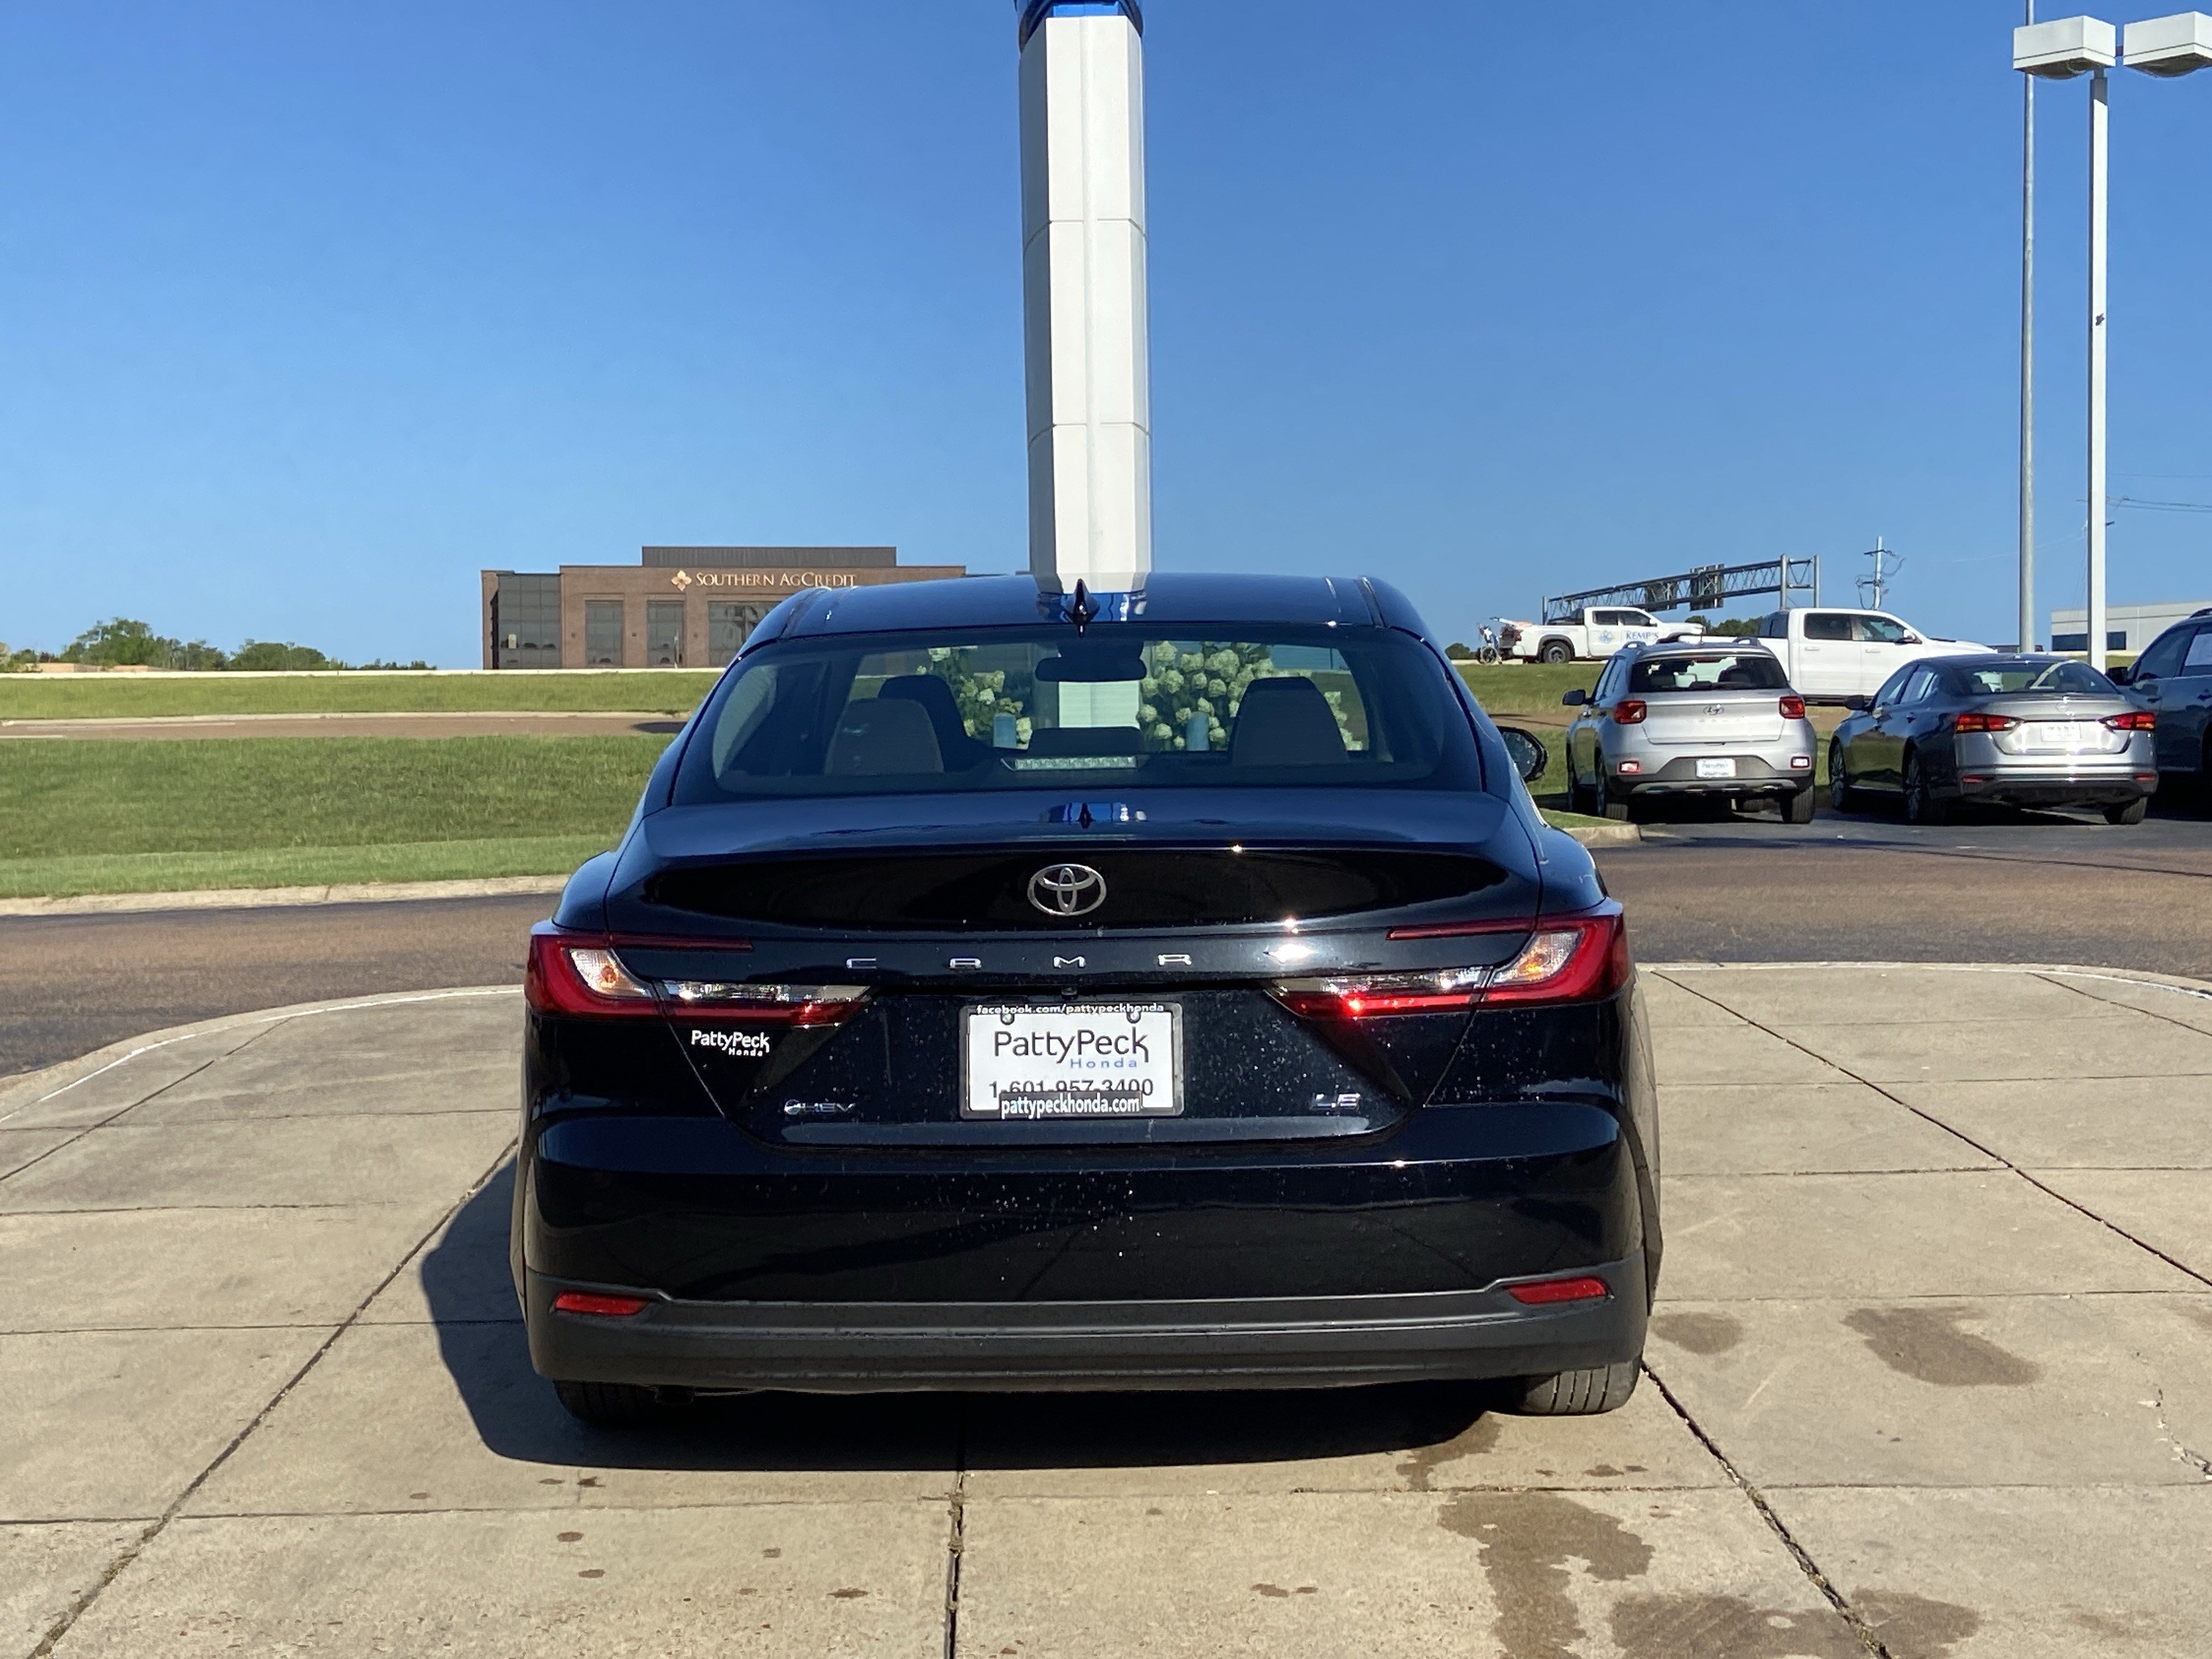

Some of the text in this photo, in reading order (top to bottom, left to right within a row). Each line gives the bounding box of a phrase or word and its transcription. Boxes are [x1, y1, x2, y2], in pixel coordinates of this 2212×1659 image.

[695, 572, 775, 587] SOUTHERN
[976, 1003, 1164, 1014] facebook.com/pattypeckhonda
[691, 1029, 770, 1053] PattyPeck
[994, 1026, 1149, 1064] PattyPeck
[728, 1047, 763, 1057] Honda
[1070, 1058, 1137, 1069] Honda
[1001, 1093, 1141, 1120] pattypeckhonda.com
